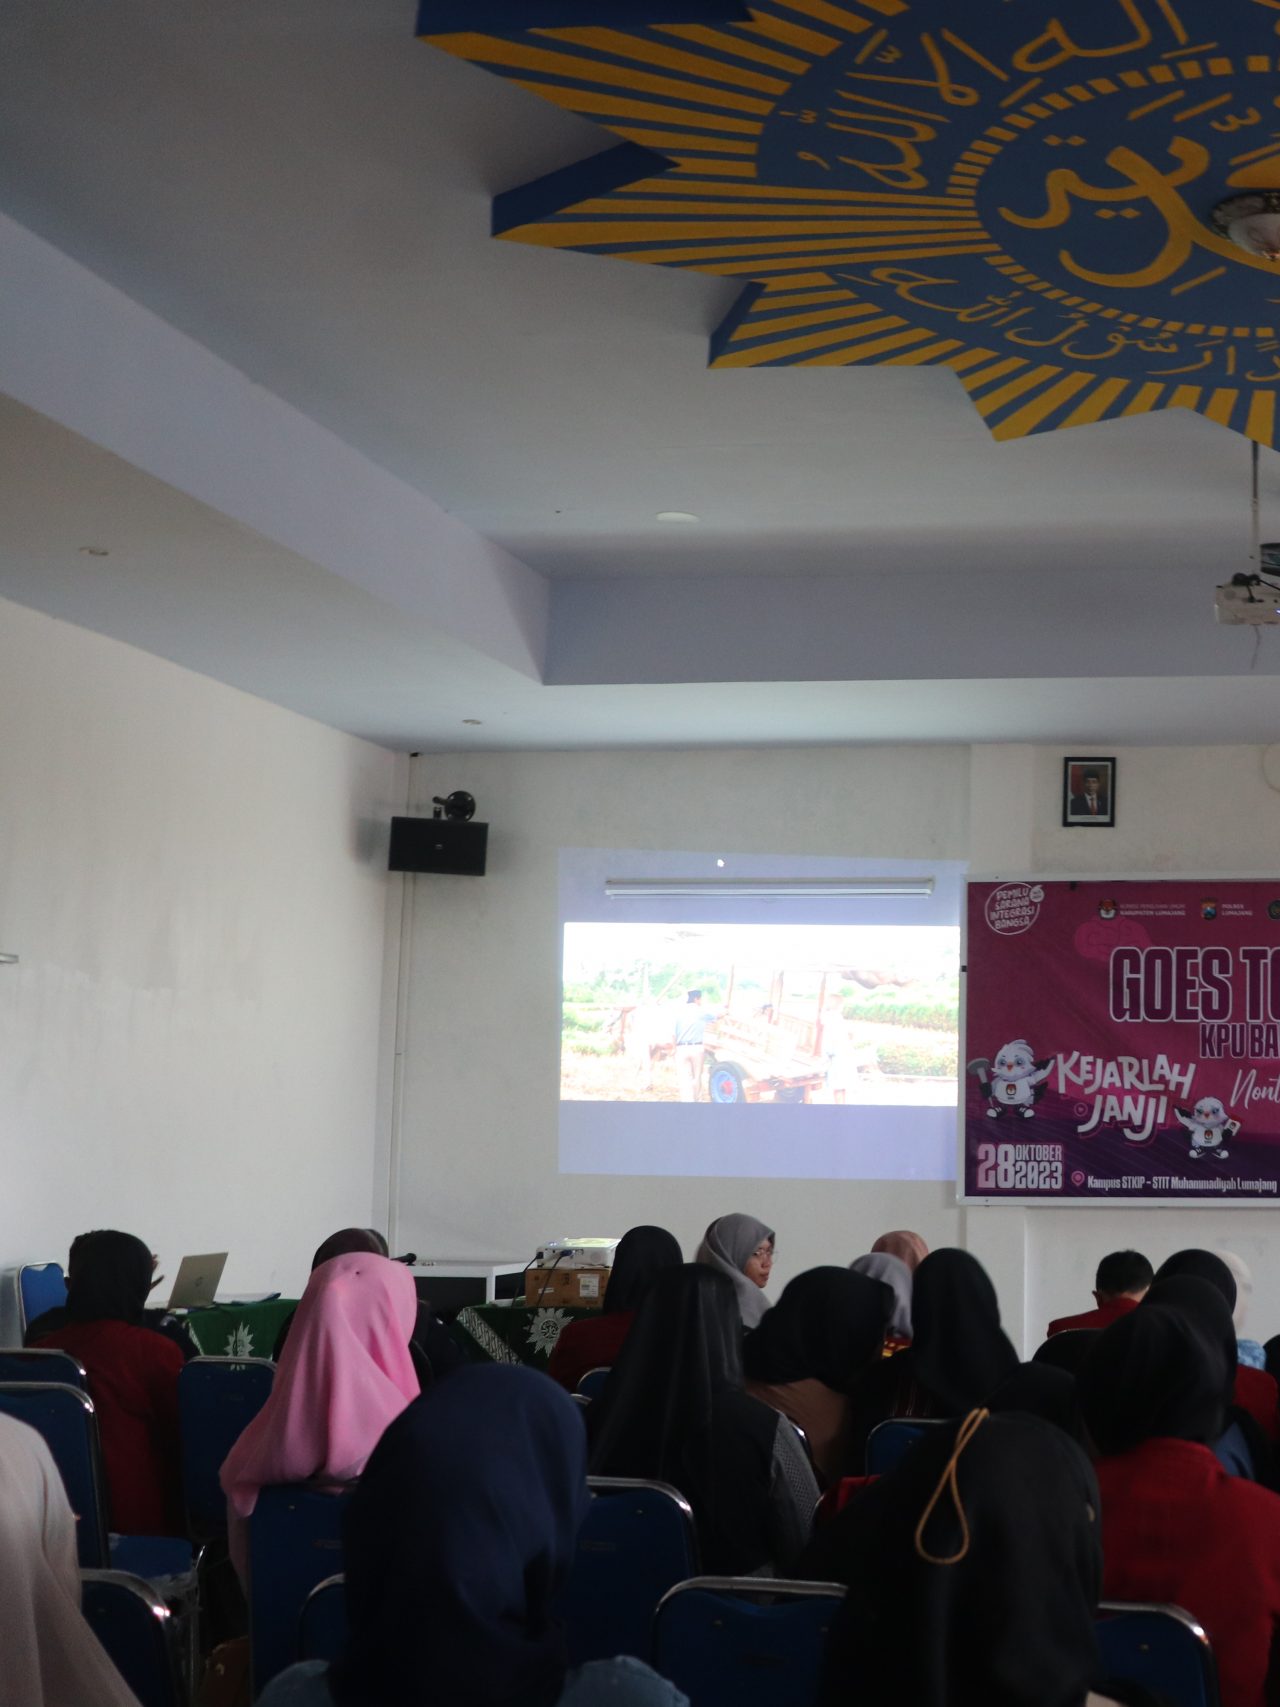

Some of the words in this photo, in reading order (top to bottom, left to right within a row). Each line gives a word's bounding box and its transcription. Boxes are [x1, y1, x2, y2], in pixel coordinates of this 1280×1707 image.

[996, 887, 1030, 901] PEMILU
[990, 905, 1036, 921] INTEGRASI
[994, 916, 1030, 930] BANGSA
[1110, 946, 1233, 1023] GOES
[1200, 1022, 1248, 1059] KPU
[1056, 1050, 1197, 1100] KEJARLAH
[1077, 1094, 1168, 1141] JANJI
[976, 1143, 1015, 1189] 28
[1014, 1144, 1063, 1161] OKTOBER
[1014, 1160, 1064, 1190] 2023
[1087, 1175, 1121, 1192] Kampus
[1121, 1175, 1146, 1190] STKIP
[1152, 1175, 1170, 1190] STIT
[1171, 1176, 1236, 1193] Muhammadiyah
[1237, 1177, 1278, 1193] Lumajang
